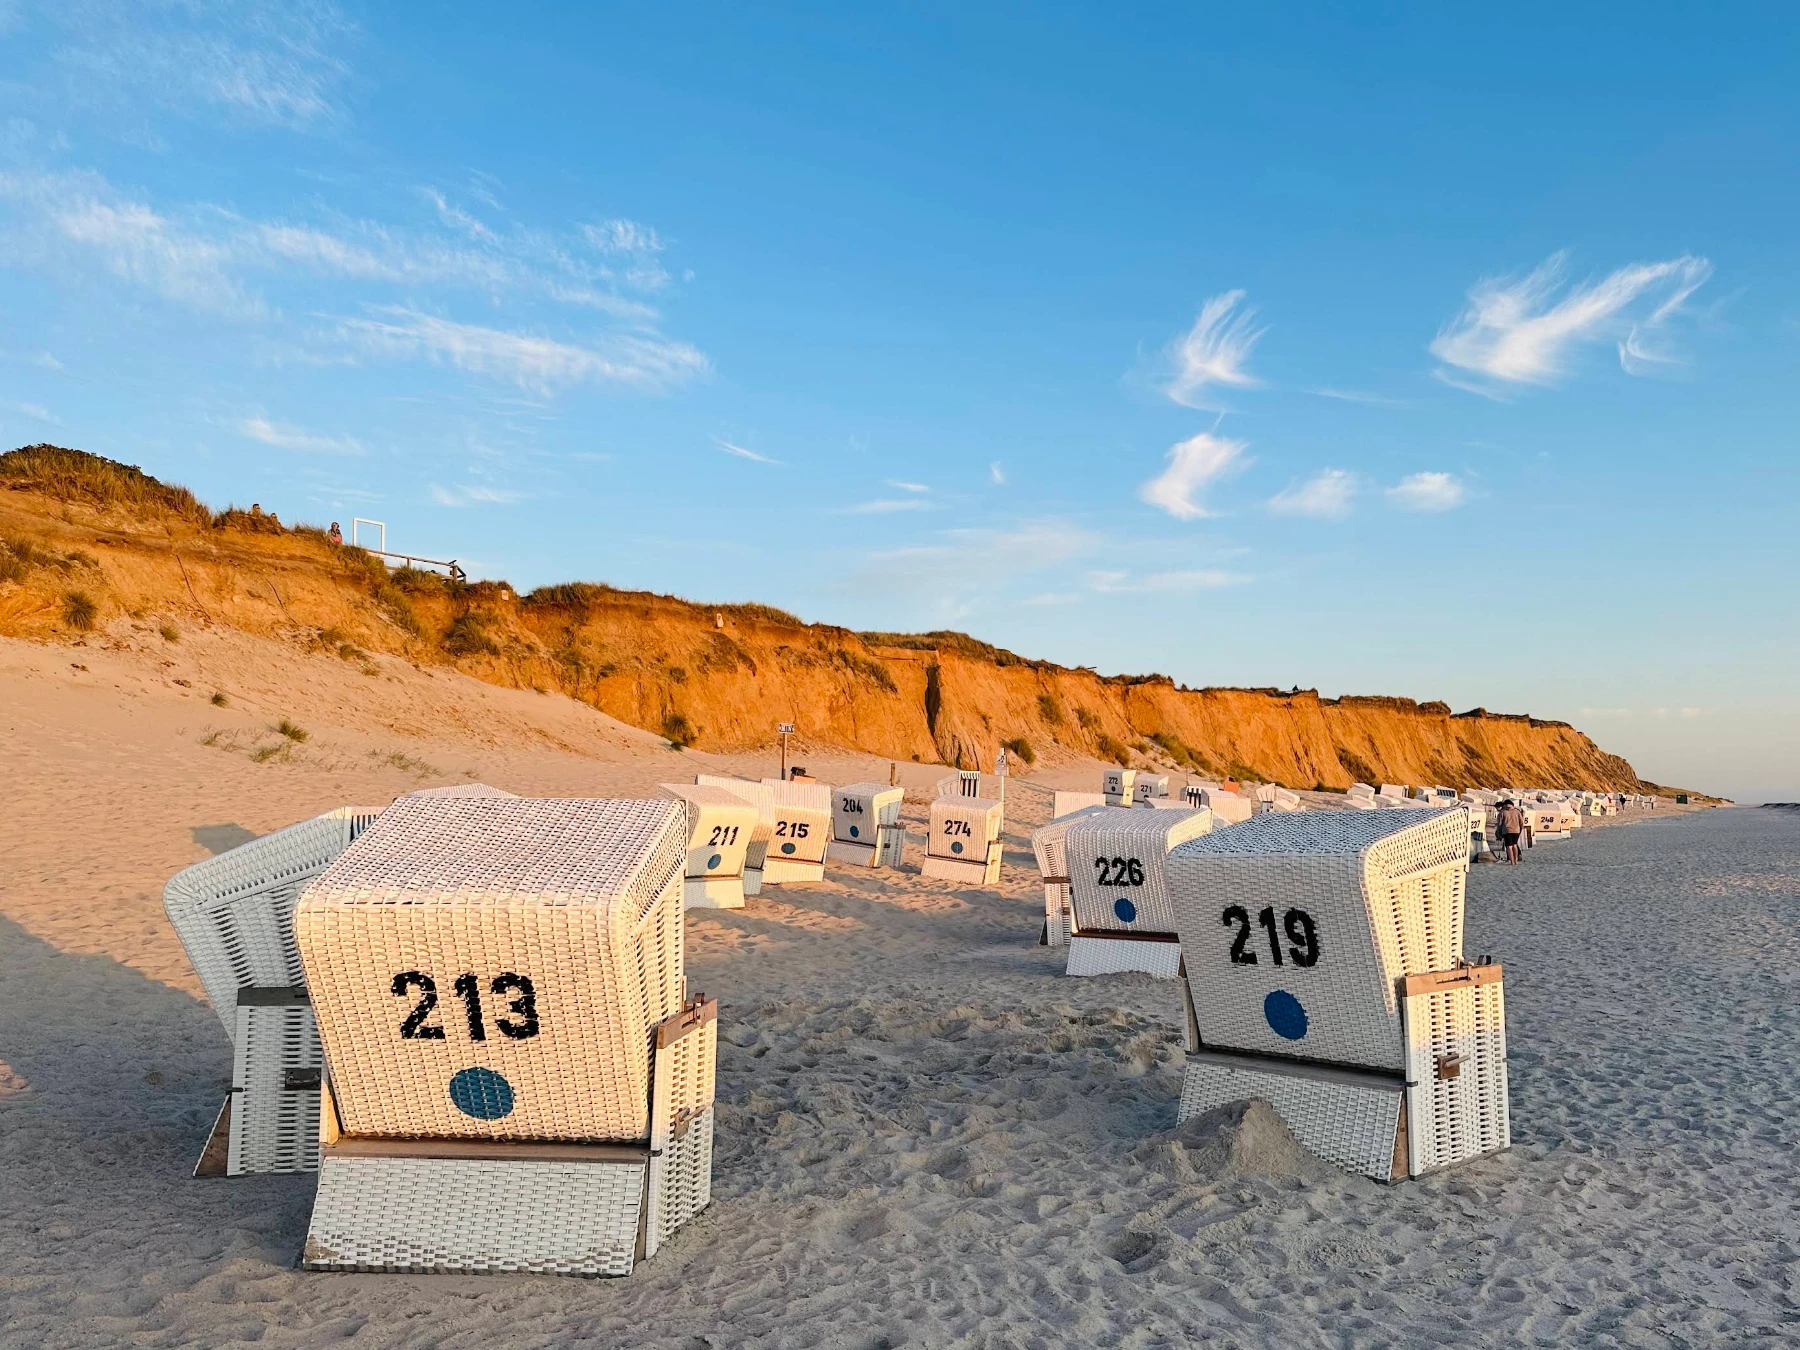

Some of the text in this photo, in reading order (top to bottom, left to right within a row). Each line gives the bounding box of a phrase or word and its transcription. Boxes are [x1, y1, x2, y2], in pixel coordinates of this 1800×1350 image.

[1108, 776, 1119, 785] 272
[1140, 784, 1152, 793] 271
[842, 797, 864, 815] 204
[708, 825, 739, 846] 211
[775, 820, 810, 838] 215
[944, 819, 972, 837] 274
[1095, 856, 1145, 887] 226
[1222, 905, 1320, 967] 219
[391, 971, 540, 1041] 213
